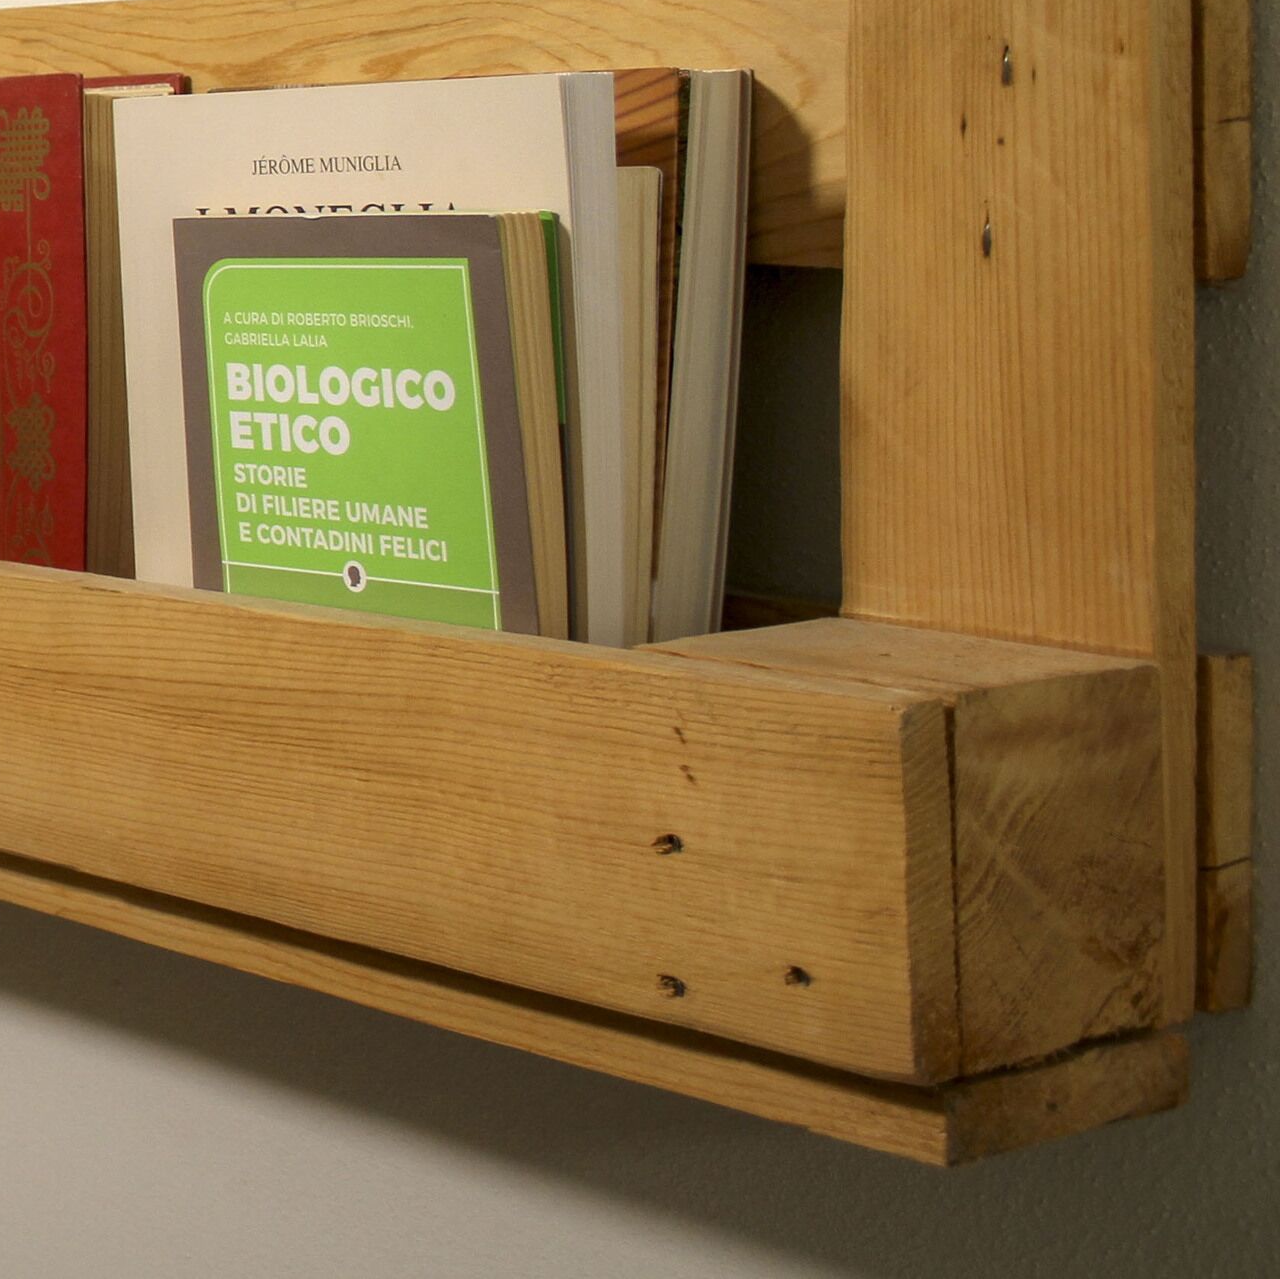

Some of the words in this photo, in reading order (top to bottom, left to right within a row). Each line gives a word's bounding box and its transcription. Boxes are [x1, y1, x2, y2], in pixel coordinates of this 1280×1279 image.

[252, 154, 316, 176] JÉRÔME
[319, 155, 402, 173] MUNIGLIA
[223, 312, 233, 325] A
[234, 312, 268, 325] CURA
[271, 312, 284, 326] DI
[287, 313, 346, 327] ROBERTO
[224, 332, 289, 347] GABRIELLA
[293, 334, 328, 348] LALIA
[226, 362, 456, 412] BIOLOGICO
[229, 410, 351, 456] ETICO
[233, 463, 308, 489] STORIE
[235, 492, 257, 514] DI
[262, 494, 341, 521] FILIERE
[345, 501, 429, 529] UMANE
[239, 521, 253, 543] E
[256, 523, 374, 555] CONTADINI
[379, 535, 448, 563] FELICI
